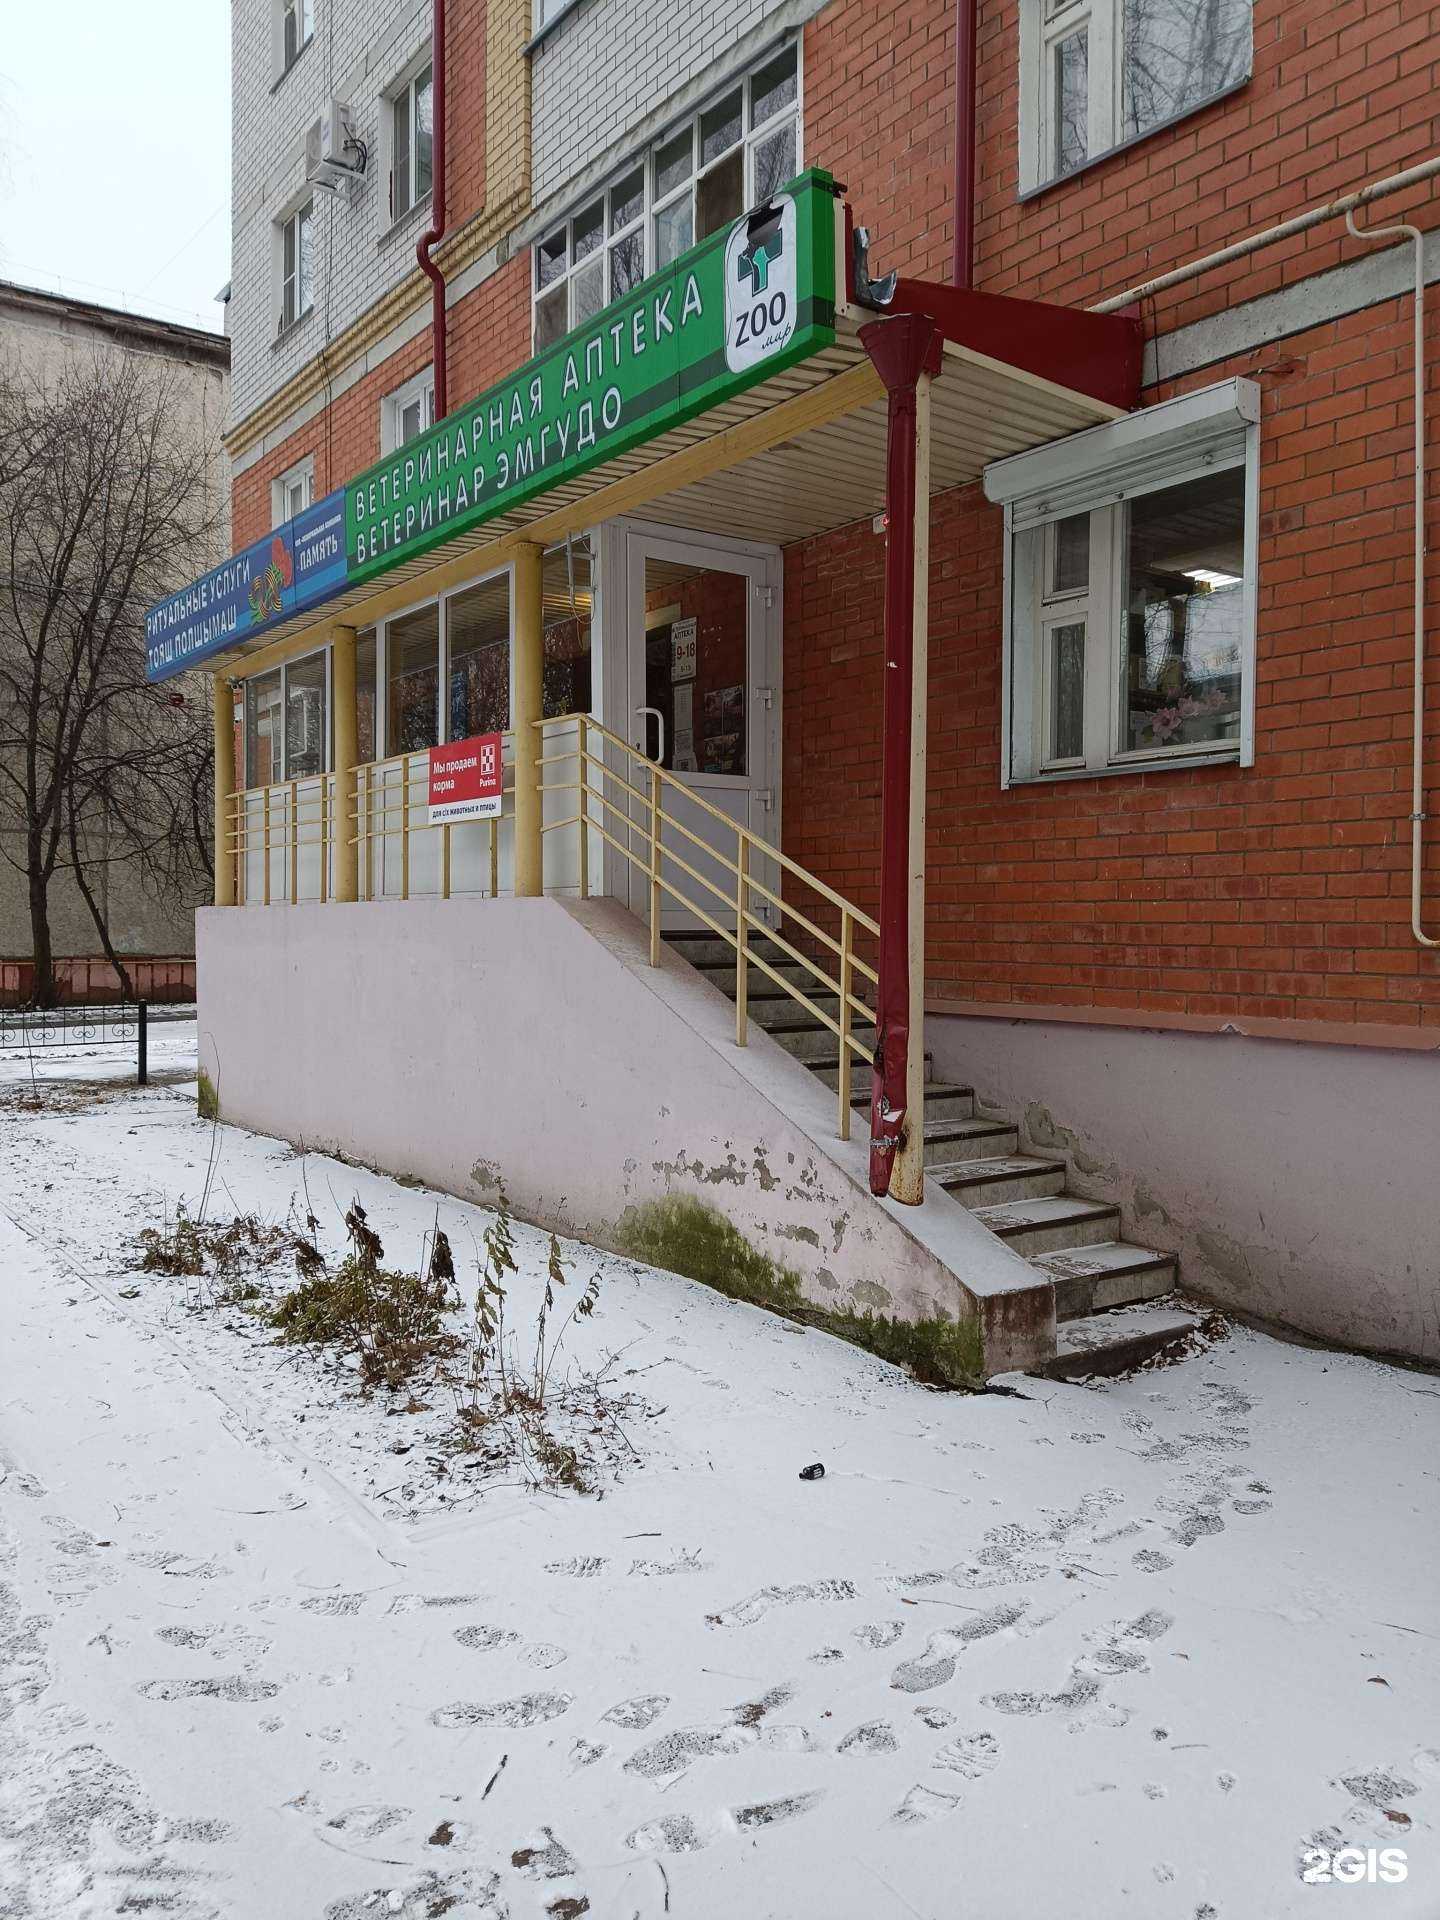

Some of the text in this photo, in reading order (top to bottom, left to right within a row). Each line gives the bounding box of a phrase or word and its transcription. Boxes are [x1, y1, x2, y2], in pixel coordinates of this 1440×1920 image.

[735, 291, 787, 348] ZOO
[762, 321, 791, 351] мир
[355, 274, 703, 522] ВЕТЕРИНАРНАЯ АПТЕКА
[356, 386, 622, 564] ВЕТЕРИНАР ЭМГУДО
[299, 533, 338, 571] ПАМЯТЬ
[146, 556, 250, 638] РИТУАЛЬНЫЕ УСЛУГИ
[148, 638, 173, 671] ТОЯШ
[676, 642, 696, 660] 9-18
[433, 757, 478, 774] Мы продаем
[433, 779, 455, 794] корма
[480, 777, 497, 788] Purina
[432, 809, 441, 818] для
[450, 805, 475, 816] животных
[480, 802, 497, 812] птицы
